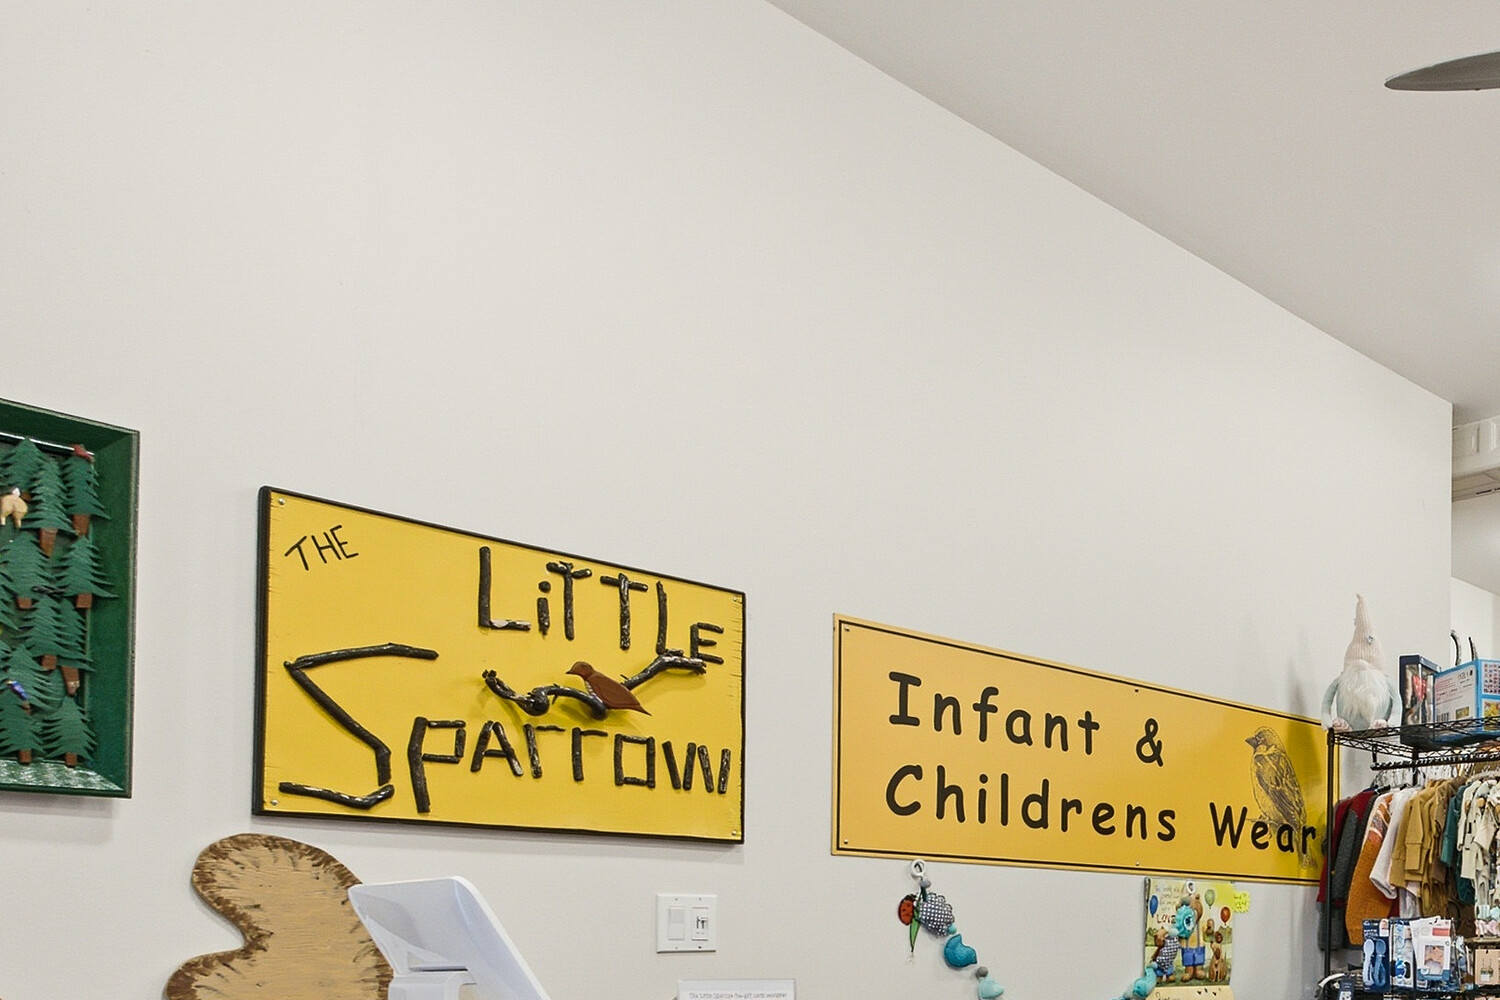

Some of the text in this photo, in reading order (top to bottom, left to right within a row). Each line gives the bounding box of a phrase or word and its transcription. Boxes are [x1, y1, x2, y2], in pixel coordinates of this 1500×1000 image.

[284, 524, 360, 572] THE
[888, 671, 1165, 767] Infant &
[885, 764, 1318, 856] Childrens Wear
